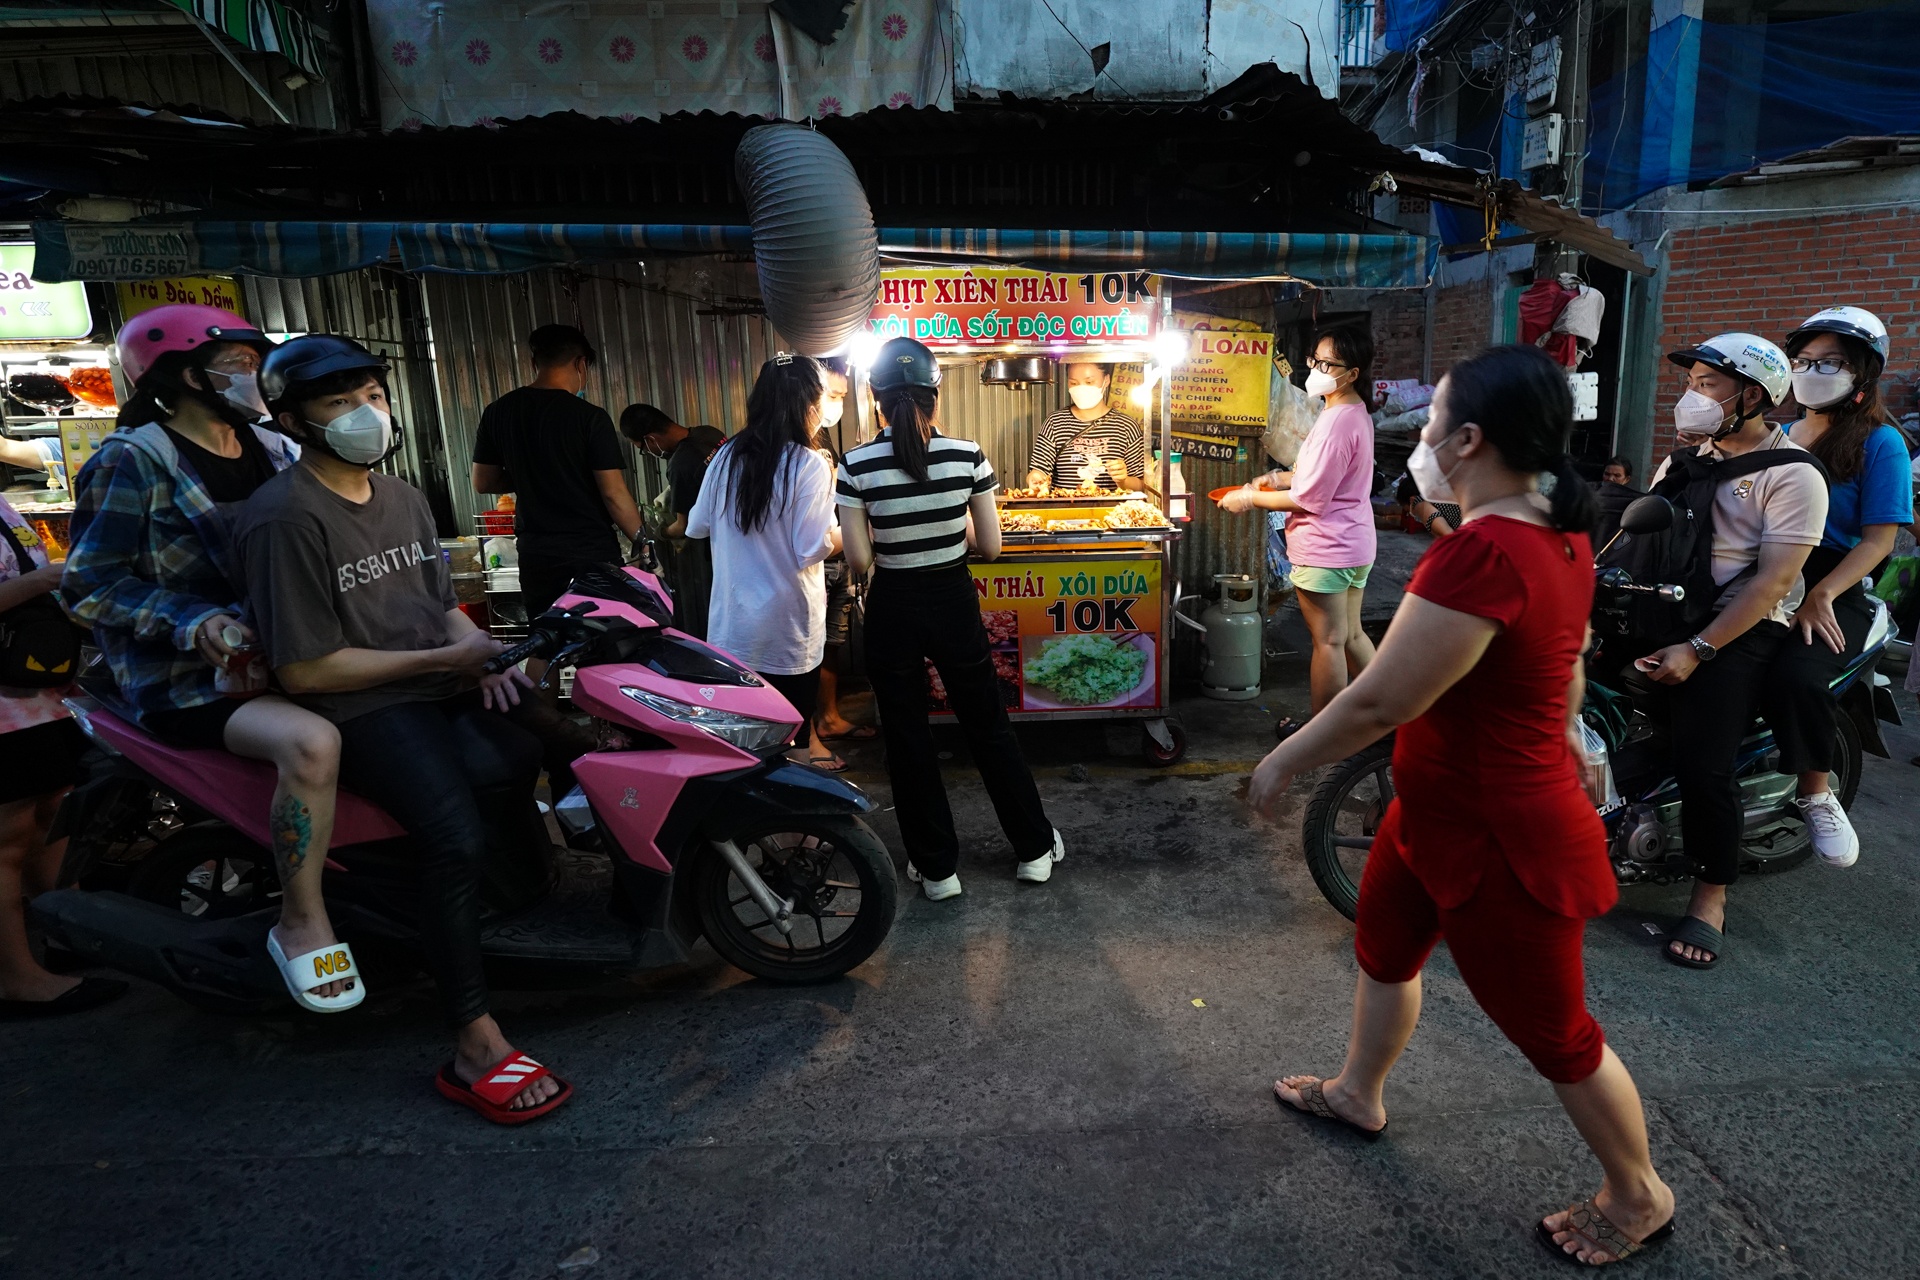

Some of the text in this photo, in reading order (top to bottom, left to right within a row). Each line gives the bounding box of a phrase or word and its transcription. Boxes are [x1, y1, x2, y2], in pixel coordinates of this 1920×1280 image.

[76, 257, 187, 275] 0907.065667
[164, 280, 197, 305] Đào
[876, 271, 1154, 311] HỊT XIÊN THÁI 10K
[868, 314, 909, 337] XÔI
[916, 312, 962, 337] DỨA
[967, 309, 1012, 337] SỐT
[1017, 312, 1065, 341] ĐỘC
[1071, 308, 1149, 338] QUYỀN
[1201, 338, 1269, 356] LOAN
[1119, 362, 1144, 374] CHU
[1208, 446, 1233, 459] Q.10
[337, 538, 437, 593] ESSENTIAL
[993, 570, 1045, 599] THÁI
[1058, 571, 1096, 597] XÔI
[1103, 569, 1149, 596] DỨA
[1046, 597, 1140, 633] 10K
[313, 950, 351, 978] NB
